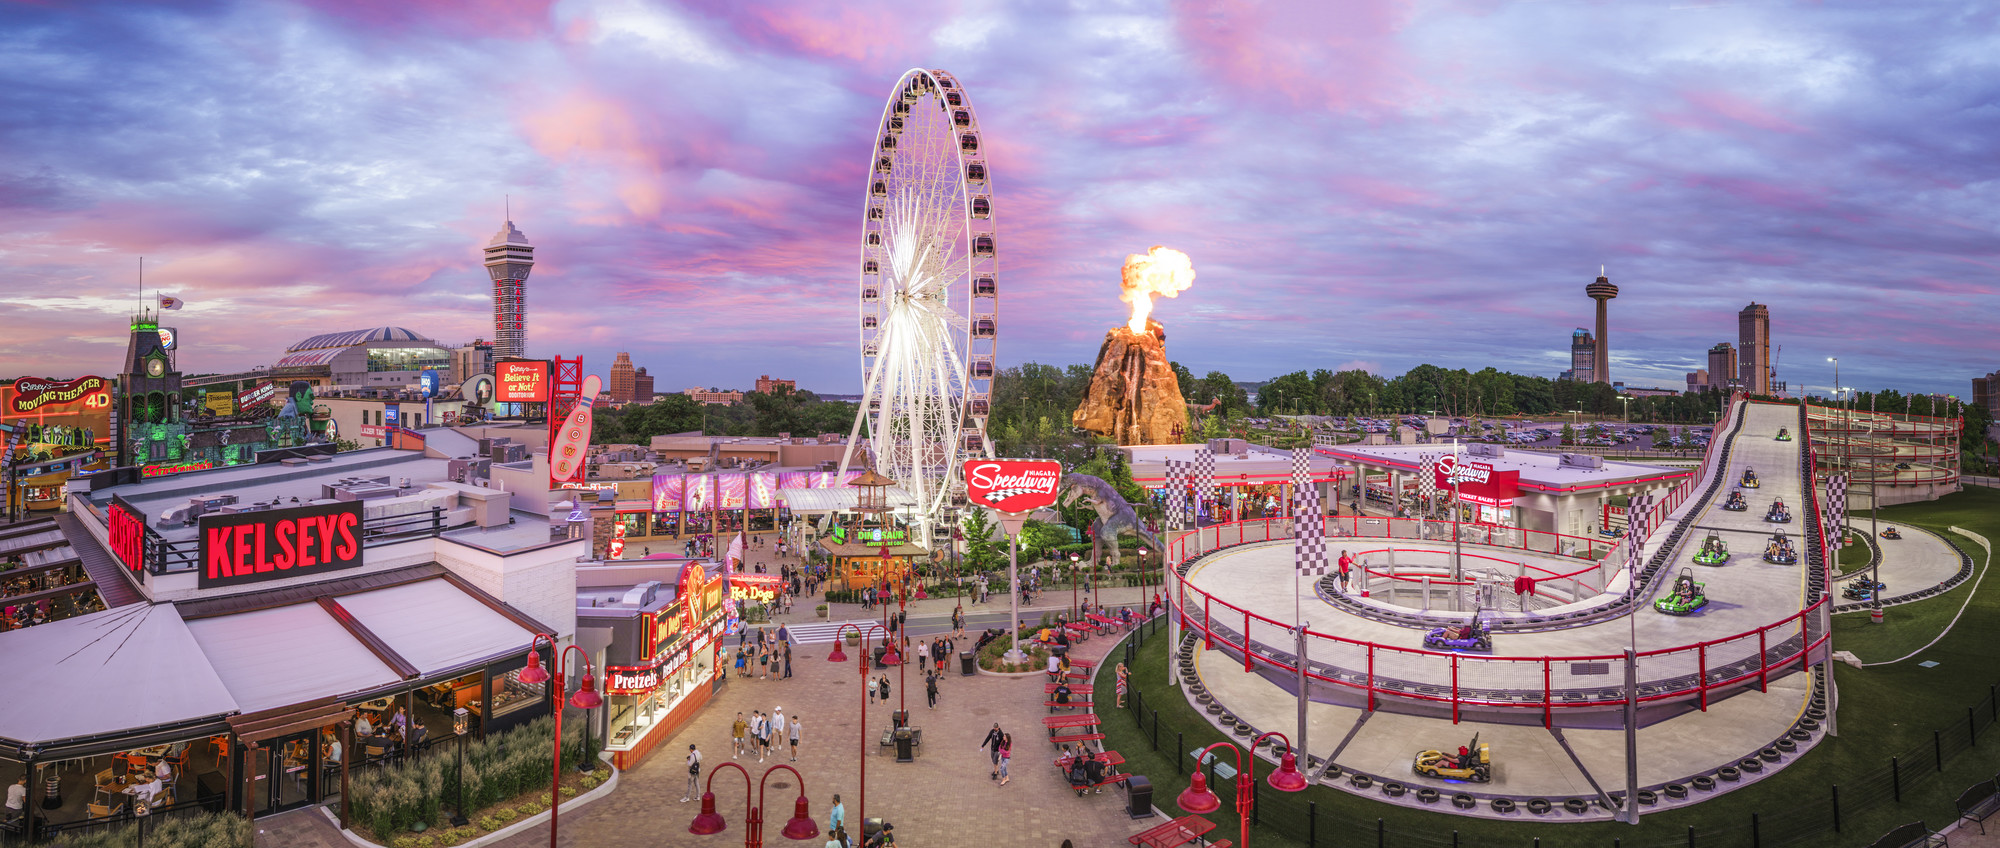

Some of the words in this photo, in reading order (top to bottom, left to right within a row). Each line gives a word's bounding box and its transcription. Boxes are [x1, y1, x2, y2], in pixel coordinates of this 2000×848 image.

[504, 373, 530, 382] Believe
[532, 373, 540, 382] It
[518, 382, 534, 392] Not!
[19, 391, 56, 410] MOVING
[57, 379, 100, 400] THEATER
[86, 393, 109, 408] 4D
[240, 390, 260, 403] BURGER
[260, 383, 272, 394] KING
[143, 459, 212, 477] Frankenstein
[971, 464, 1056, 494] Speedway
[108, 503, 143, 572] KELSEYS
[207, 512, 358, 579] KELSEYS
[730, 586, 748, 600] Hot
[750, 586, 774, 603] Dogs
[658, 619, 668, 643] Hot
[614, 673, 657, 689] Pretzels
